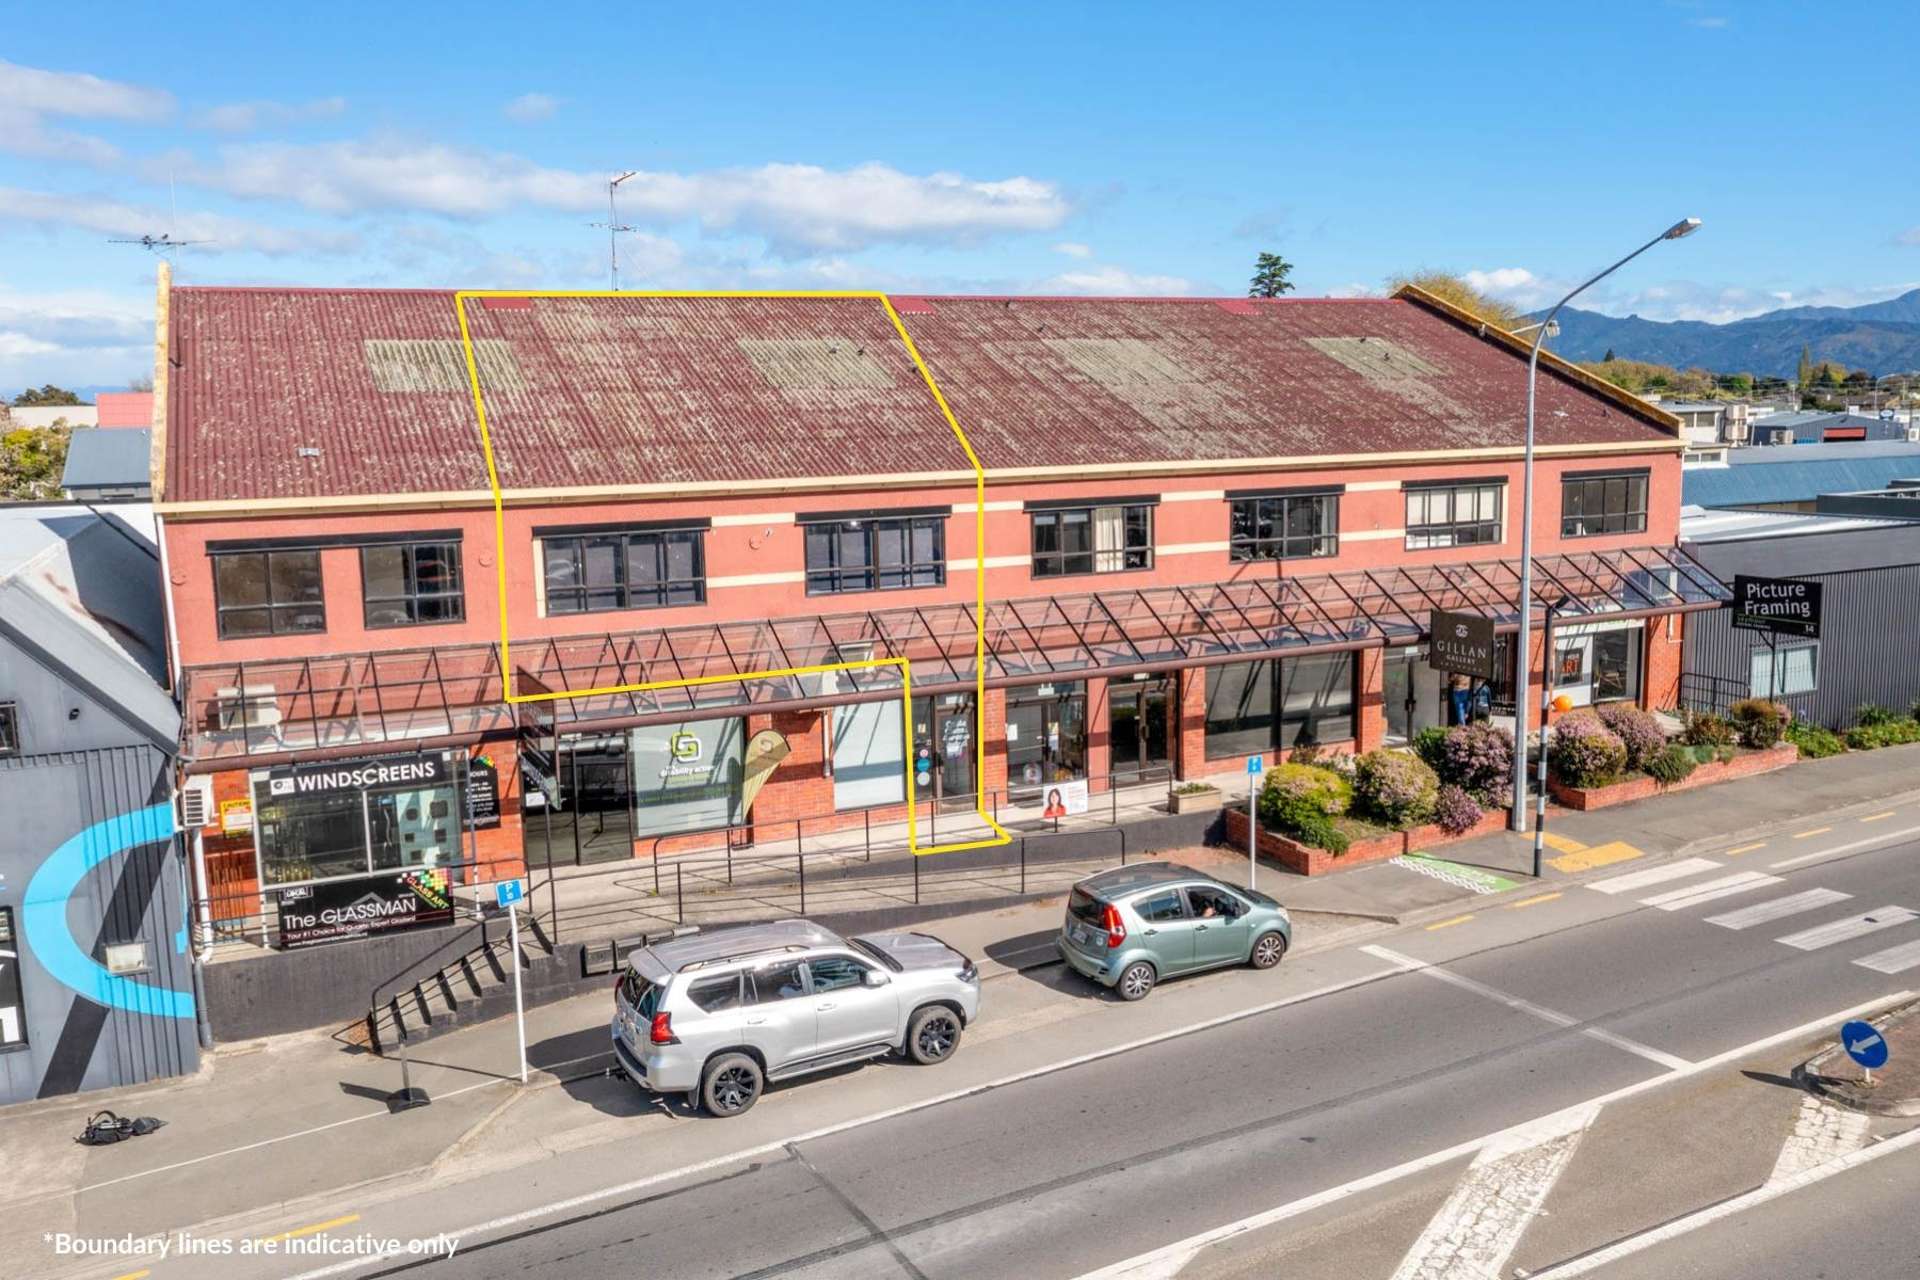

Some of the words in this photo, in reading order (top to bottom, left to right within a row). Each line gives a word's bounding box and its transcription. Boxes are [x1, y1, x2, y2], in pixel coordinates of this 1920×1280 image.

[1746, 583, 1806, 599] Picture
[1744, 599, 1811, 618] Framing
[1805, 624, 1815, 633] 14
[1437, 640, 1487, 659] GILLAN
[297, 761, 436, 792] WINDSCREENS
[283, 914, 316, 930] The
[321, 898, 417, 925] GLASSMAN
[312, 927, 336, 938] Choice
